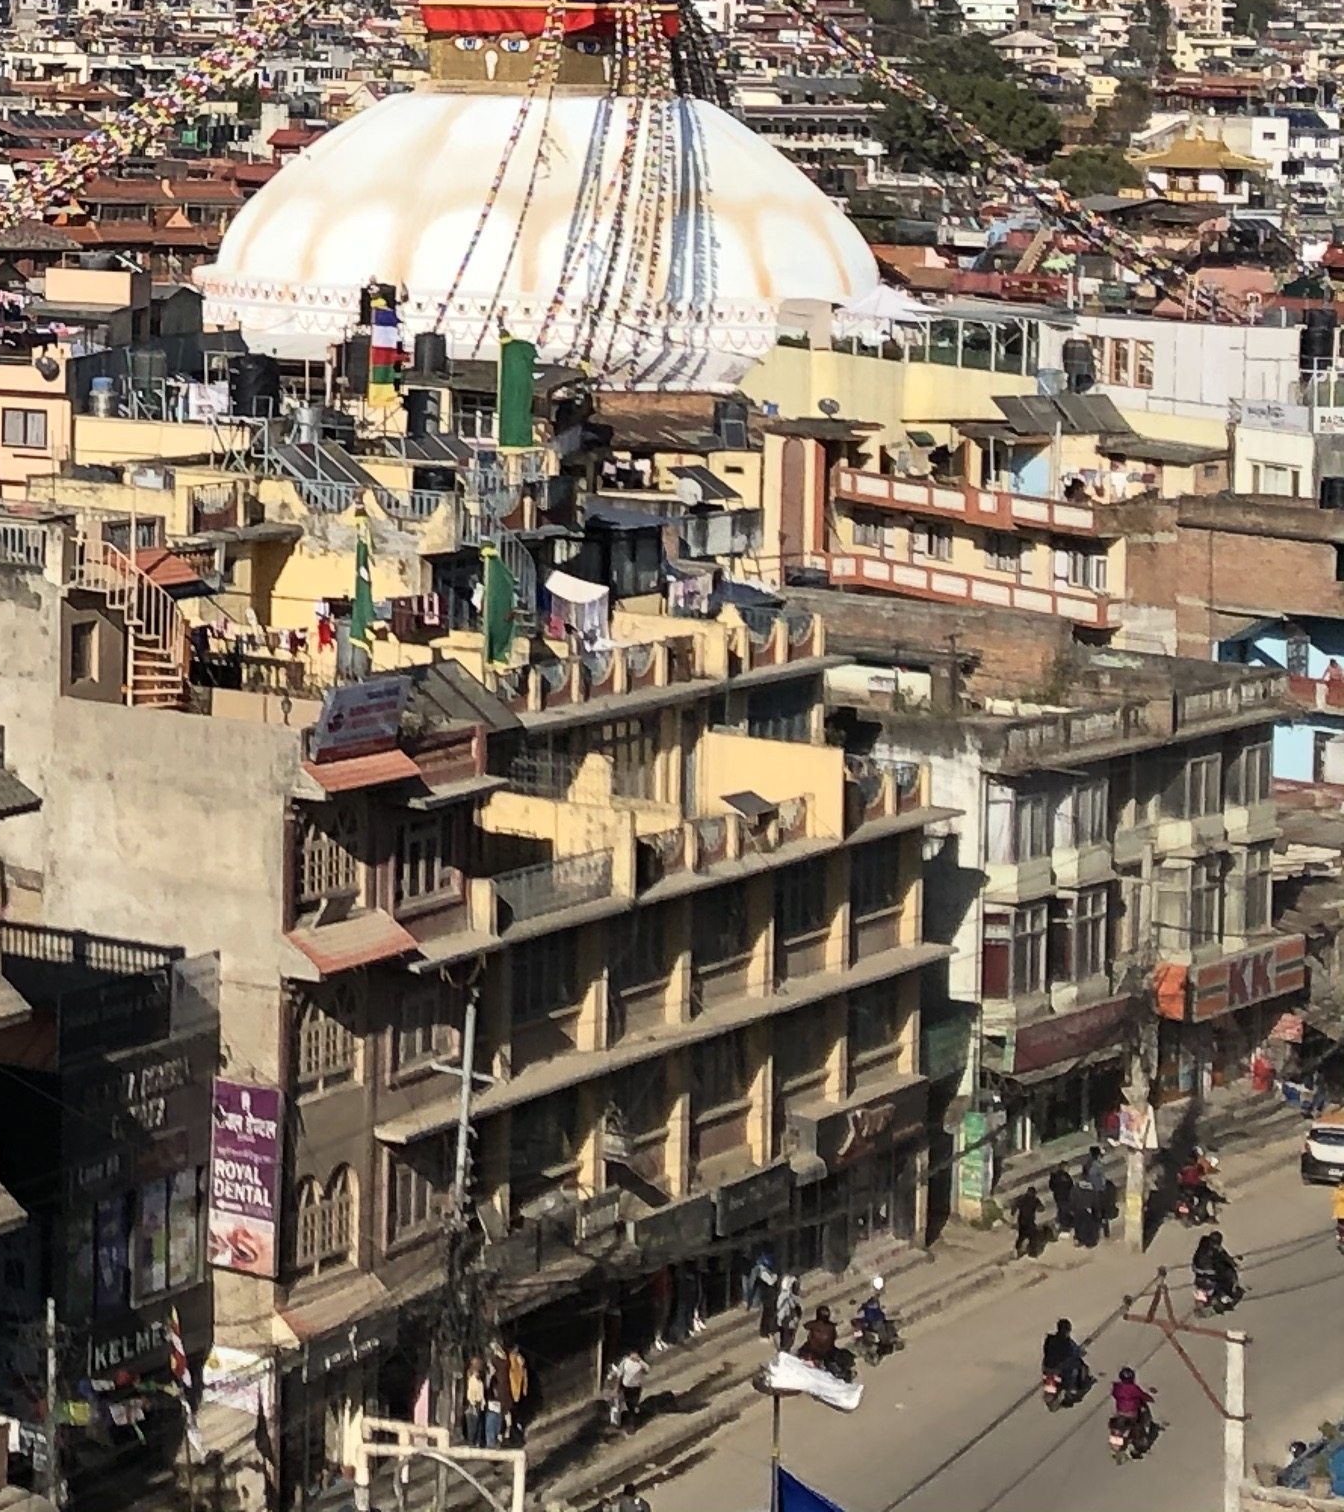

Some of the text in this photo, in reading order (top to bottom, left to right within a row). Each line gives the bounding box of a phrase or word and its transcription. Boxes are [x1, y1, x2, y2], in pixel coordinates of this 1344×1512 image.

[214, 1158, 262, 1186] ROYAL
[214, 1180, 271, 1207] DENTAL
[95, 1321, 163, 1370] KELME
